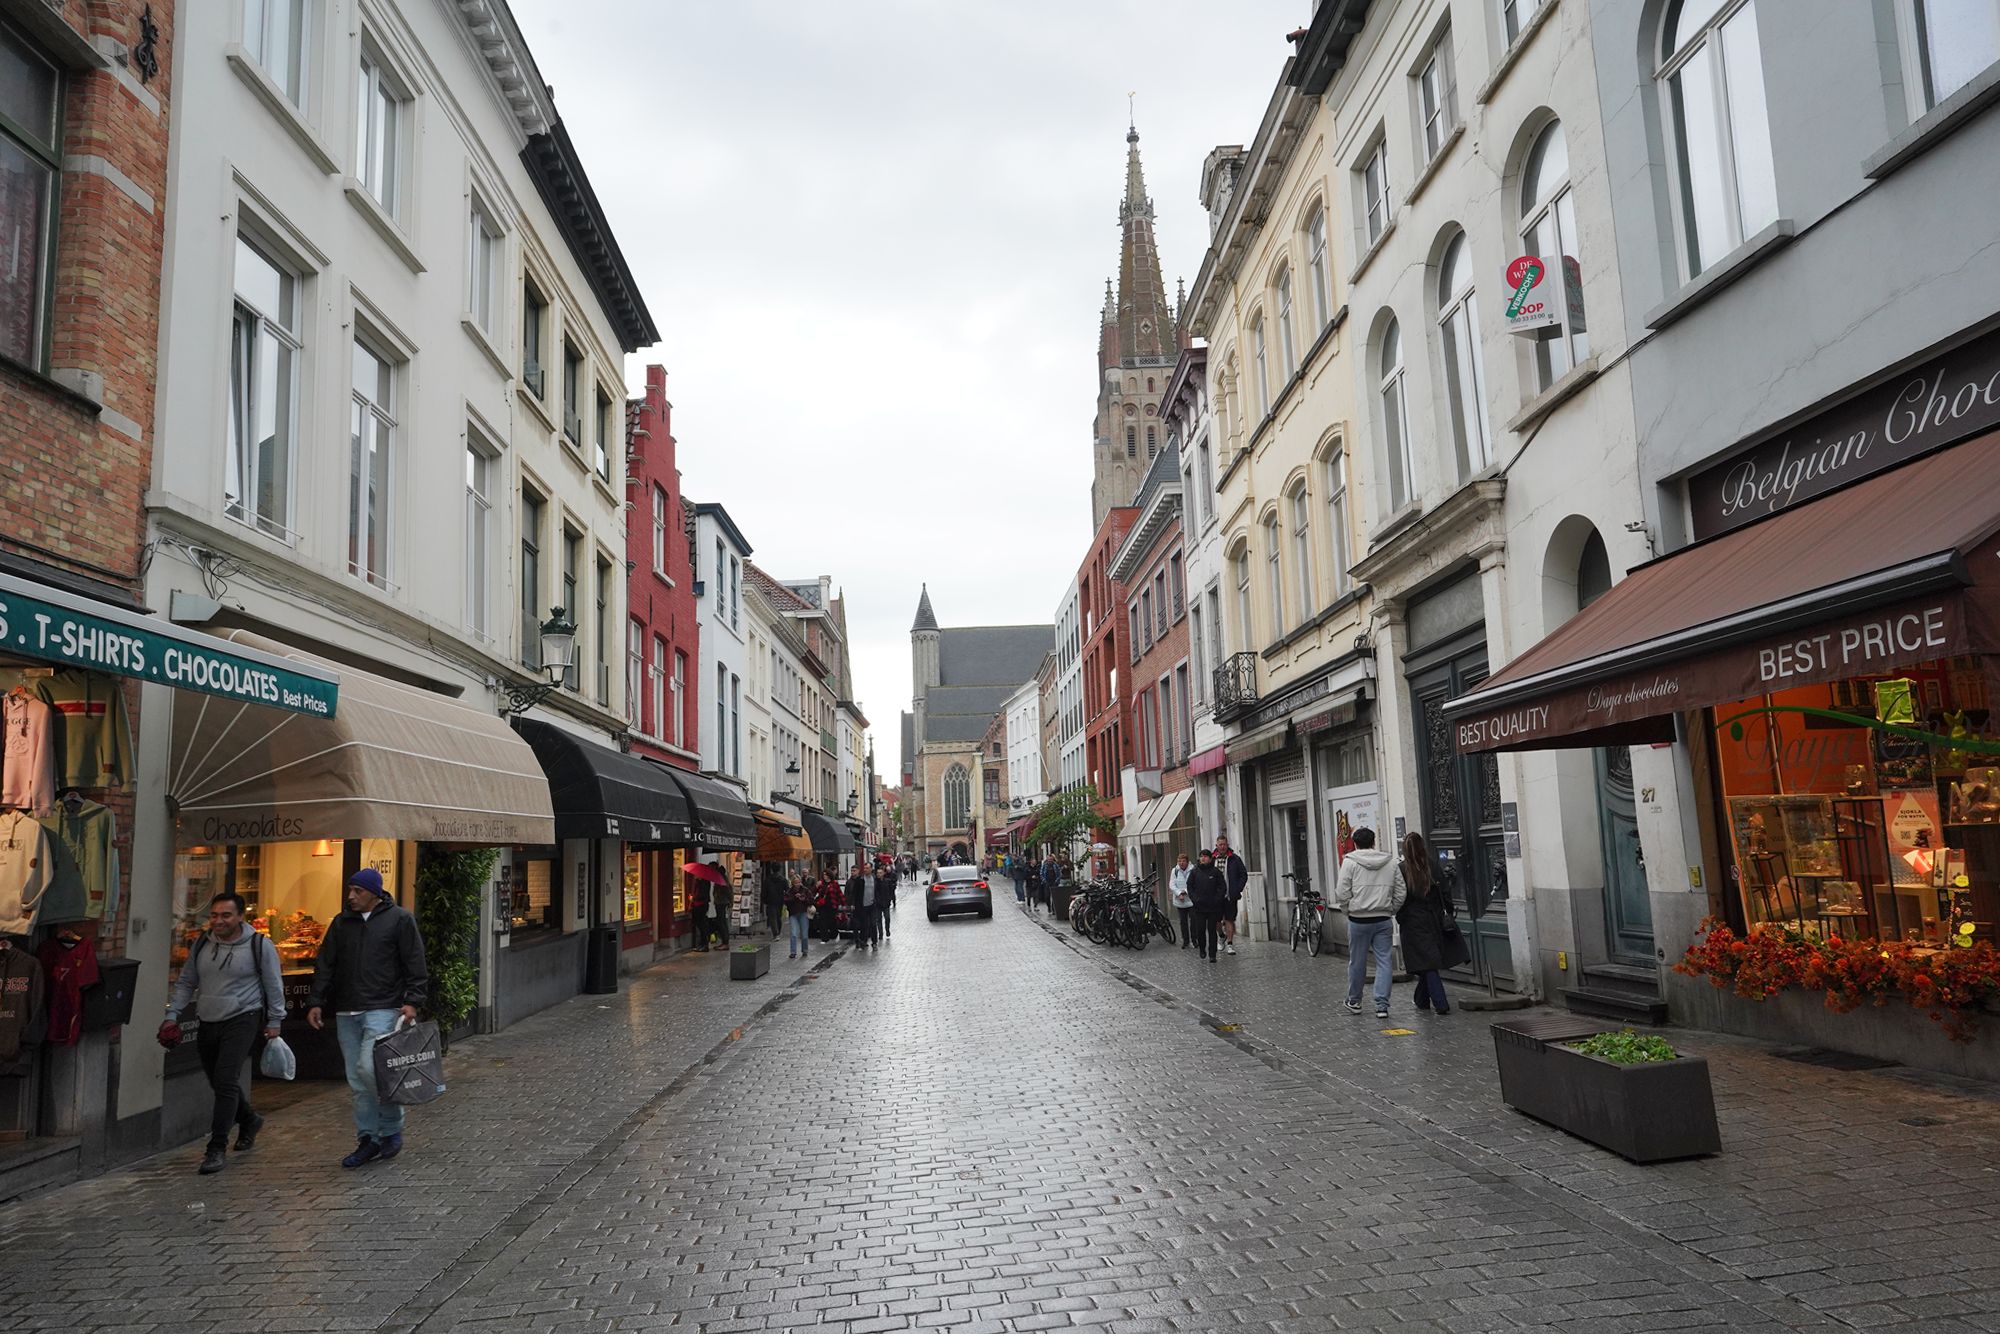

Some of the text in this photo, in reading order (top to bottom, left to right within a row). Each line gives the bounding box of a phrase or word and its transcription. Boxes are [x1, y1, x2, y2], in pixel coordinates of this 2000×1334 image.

[1510, 272, 1535, 311] VERKOCHT
[1518, 303, 1543, 315] OOP
[1721, 430, 1877, 513] Belgian
[1759, 606, 1946, 682] BEST PRICE
[35, 613, 146, 672] T-SHIRTS
[164, 648, 279, 702] CHOCOLATES
[283, 689, 302, 707] Best
[303, 694, 328, 713] Prices
[1586, 675, 1680, 717] Daya chocolates
[1459, 705, 1550, 746] BEST QUALITY
[1641, 787, 1655, 803] 27
[203, 813, 304, 841] Chocolates
[370, 859, 392, 874] SWEET
[60, 967, 71, 981] 7
[386, 1050, 437, 1069] SNIPES.COM
